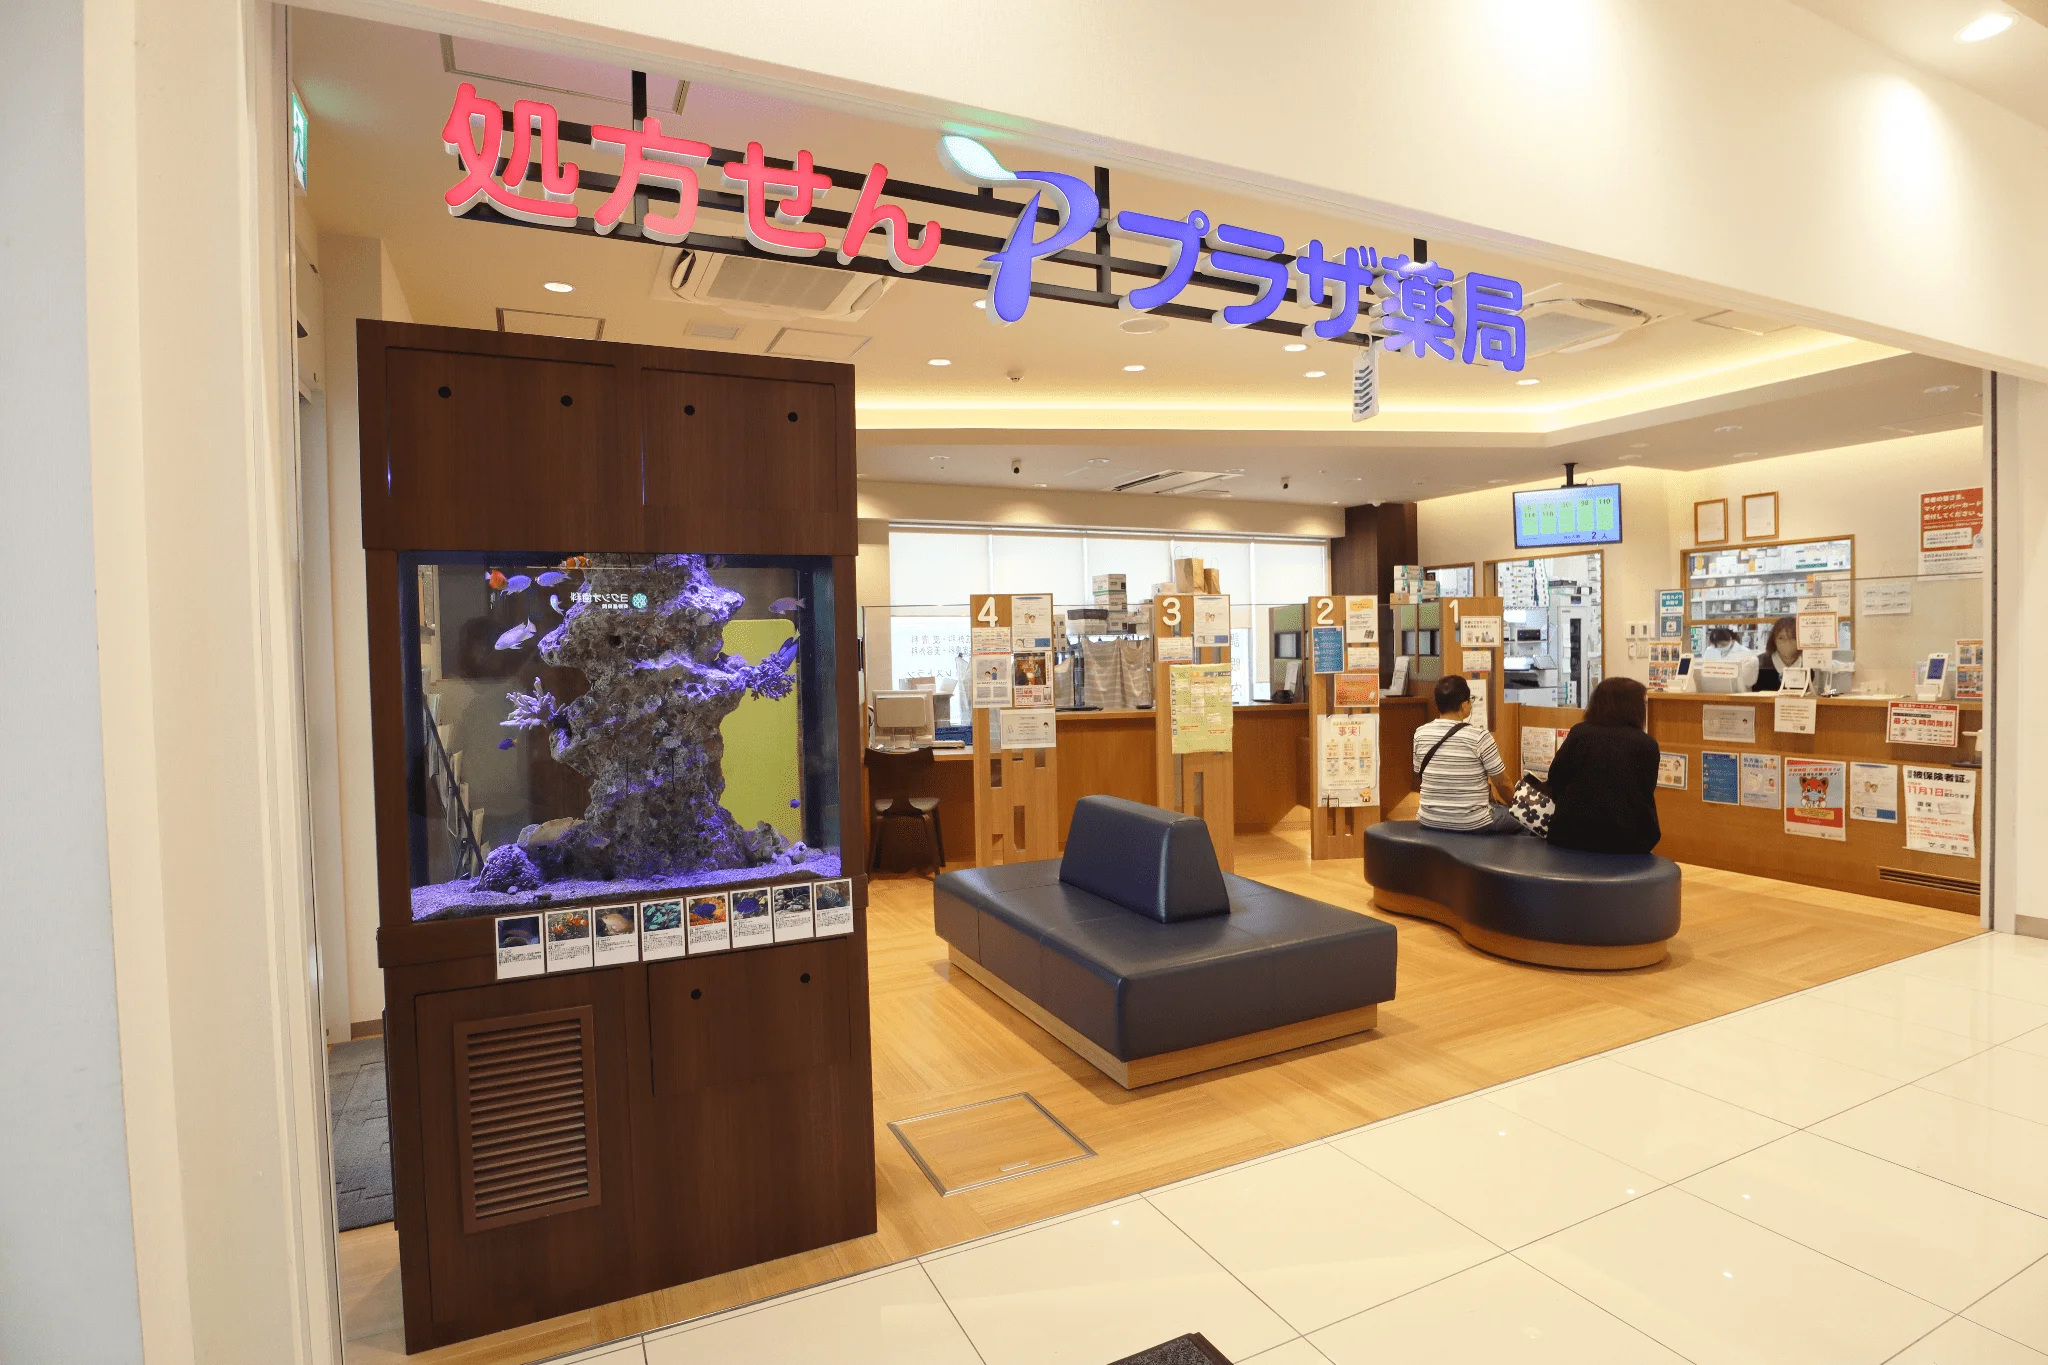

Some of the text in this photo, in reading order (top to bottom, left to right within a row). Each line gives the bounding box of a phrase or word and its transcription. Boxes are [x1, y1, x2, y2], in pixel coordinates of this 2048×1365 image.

[442, 82, 942, 274] 処方せん
[1108, 209, 1527, 373] プラザ薬局
[1591, 531, 1597, 540] 2
[977, 596, 999, 628] 4
[1162, 597, 1182, 626] 3
[1316, 598, 1335, 625] 2
[1449, 599, 1459, 624] 1
[1907, 785, 1945, 797] 11月1日
